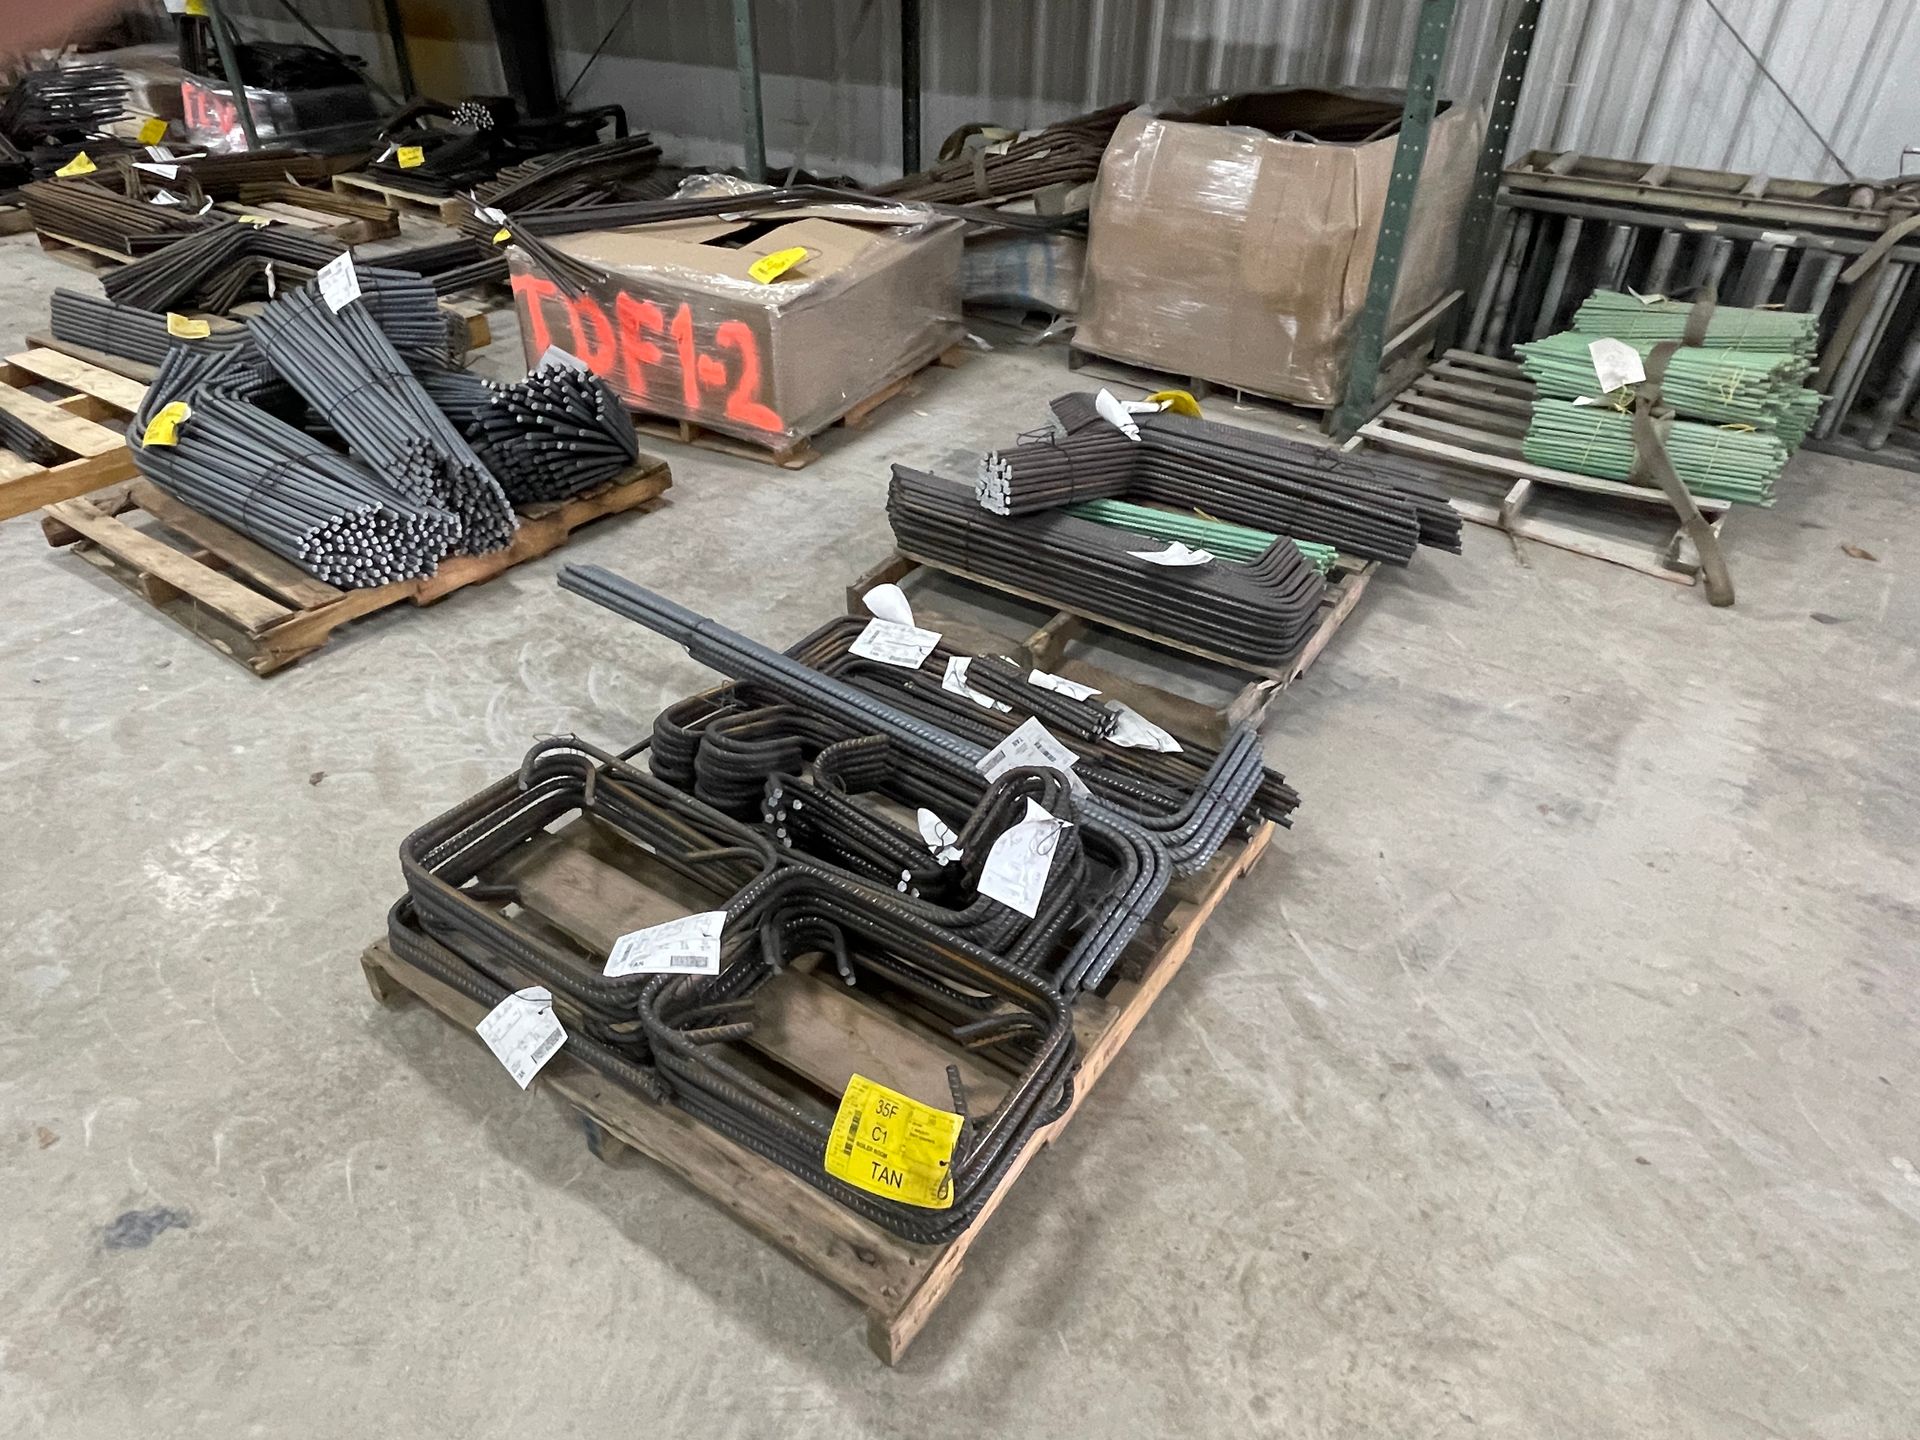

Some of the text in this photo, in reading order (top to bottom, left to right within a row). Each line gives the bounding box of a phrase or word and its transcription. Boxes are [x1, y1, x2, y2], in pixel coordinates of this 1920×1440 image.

[875, 1099, 899, 1120] 35F
[871, 1126, 888, 1144] C1
[871, 1161, 903, 1189] TAN
